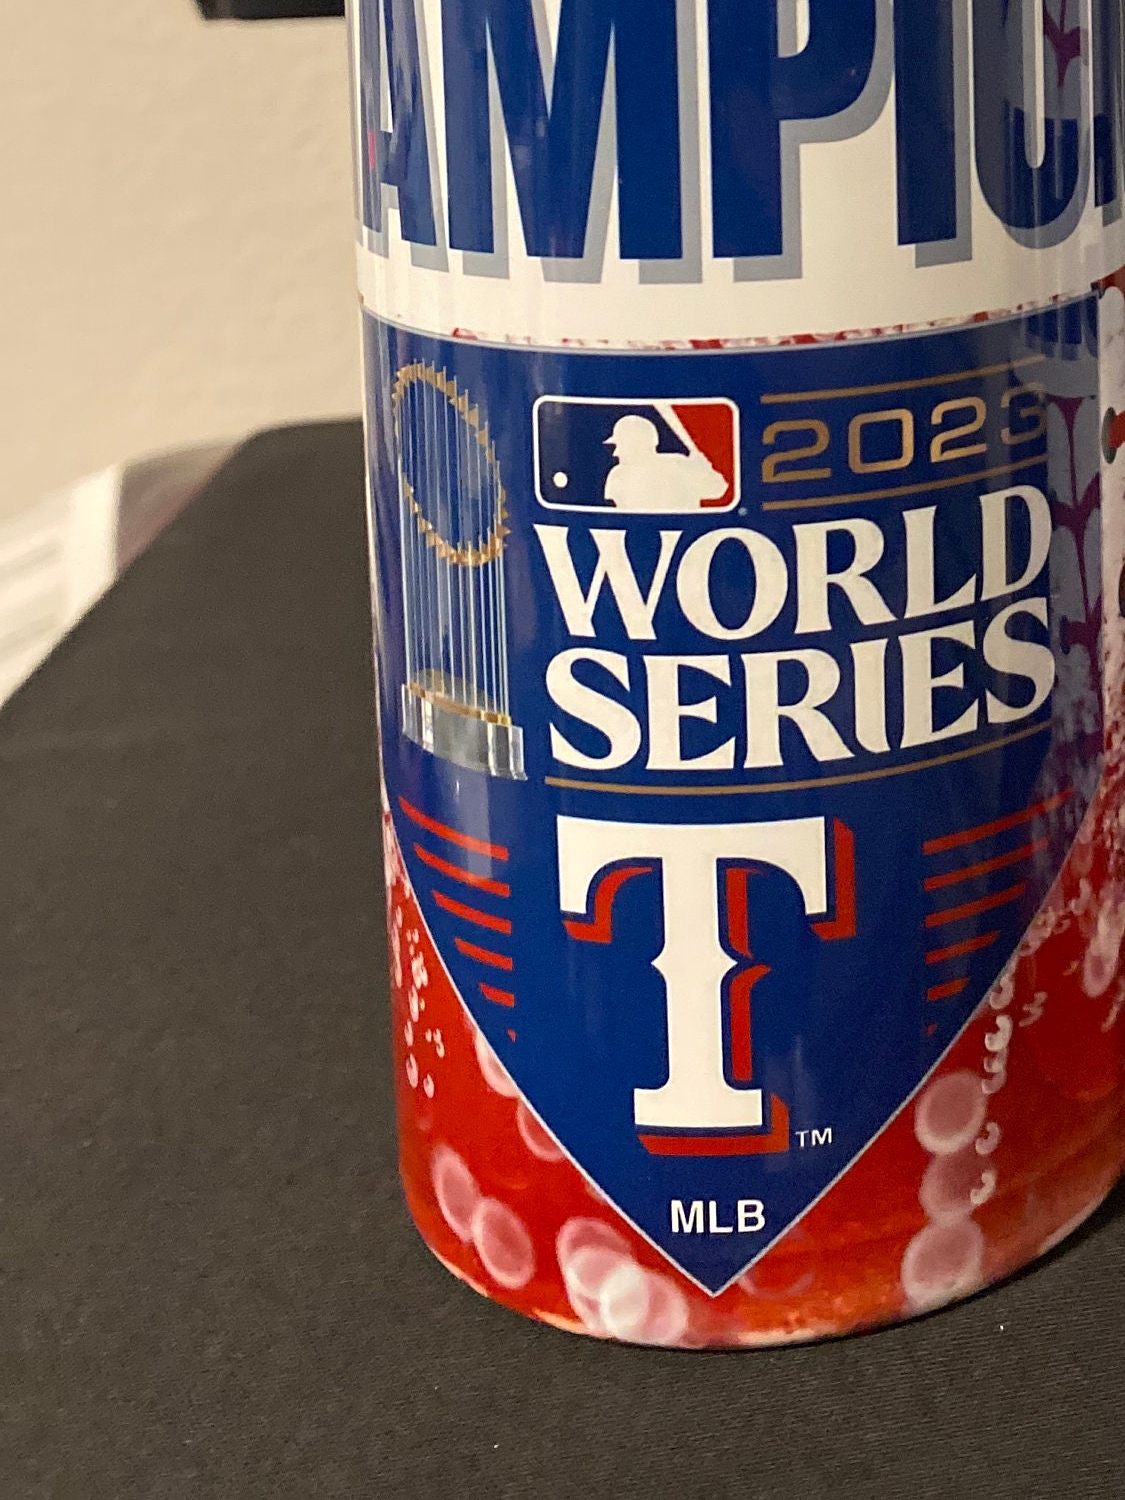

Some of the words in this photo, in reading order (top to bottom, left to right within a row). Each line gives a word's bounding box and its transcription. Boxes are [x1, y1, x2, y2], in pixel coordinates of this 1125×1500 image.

[761, 381, 1048, 483] 2023
[533, 484, 1053, 641] WORLD
[544, 598, 1056, 774] SERIES
[556, 814, 857, 1156] T
[795, 1128, 833, 1148] TM
[669, 1198, 767, 1235] MLB
